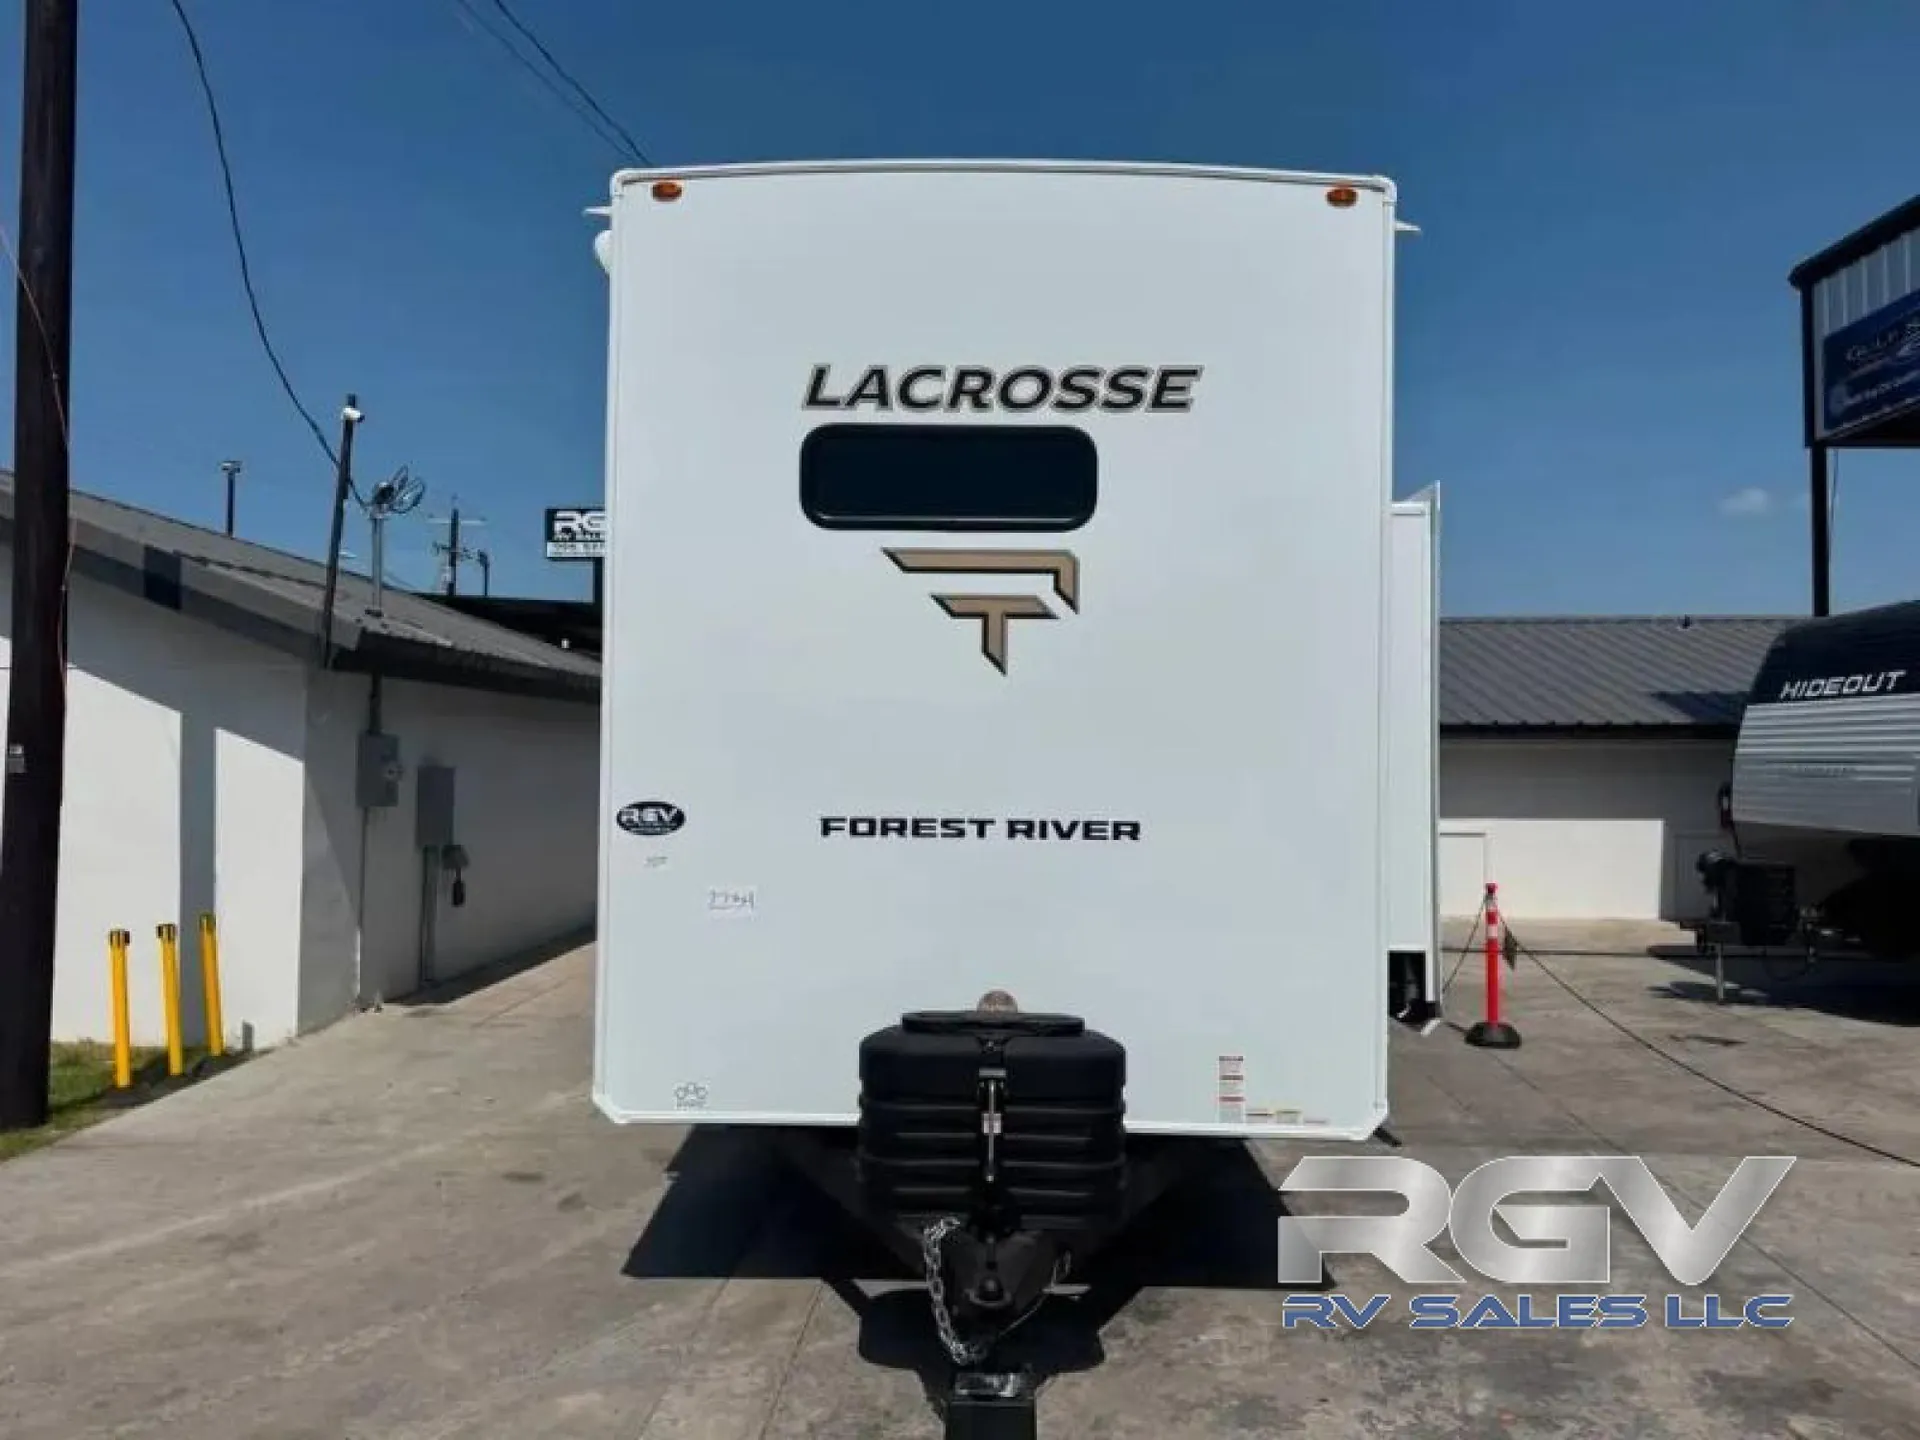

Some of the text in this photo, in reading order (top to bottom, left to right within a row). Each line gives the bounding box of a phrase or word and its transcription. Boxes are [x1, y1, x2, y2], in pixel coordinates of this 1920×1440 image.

[801, 363, 1204, 414] LACROSSE
[1780, 669, 1906, 700] HIDEOUT
[820, 816, 1142, 842] FOREST RIVER
